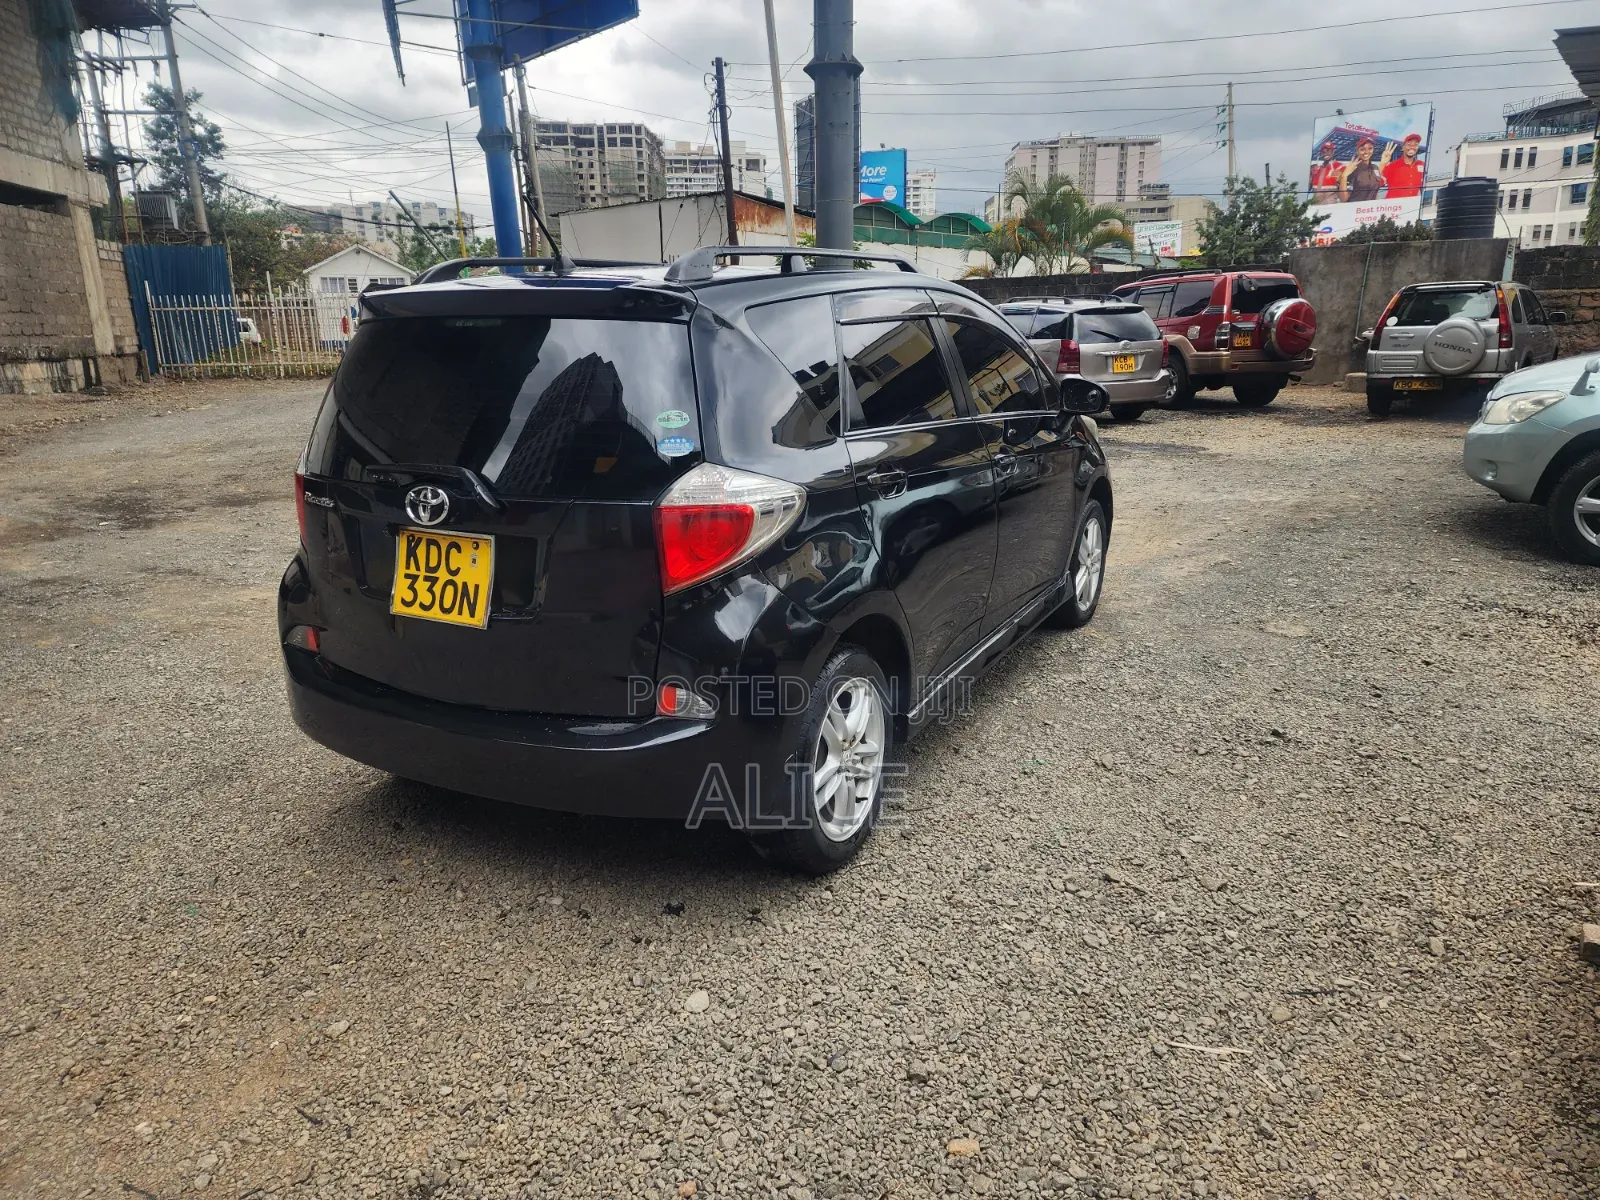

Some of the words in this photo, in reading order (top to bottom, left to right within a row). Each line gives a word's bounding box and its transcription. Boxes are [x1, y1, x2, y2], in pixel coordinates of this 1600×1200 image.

[1434, 341, 1473, 354] HONDA
[1114, 355, 1128, 364] KCB
[1116, 363, 1134, 371] 190H
[405, 532, 462, 578] KDC
[400, 573, 480, 618] 330N
